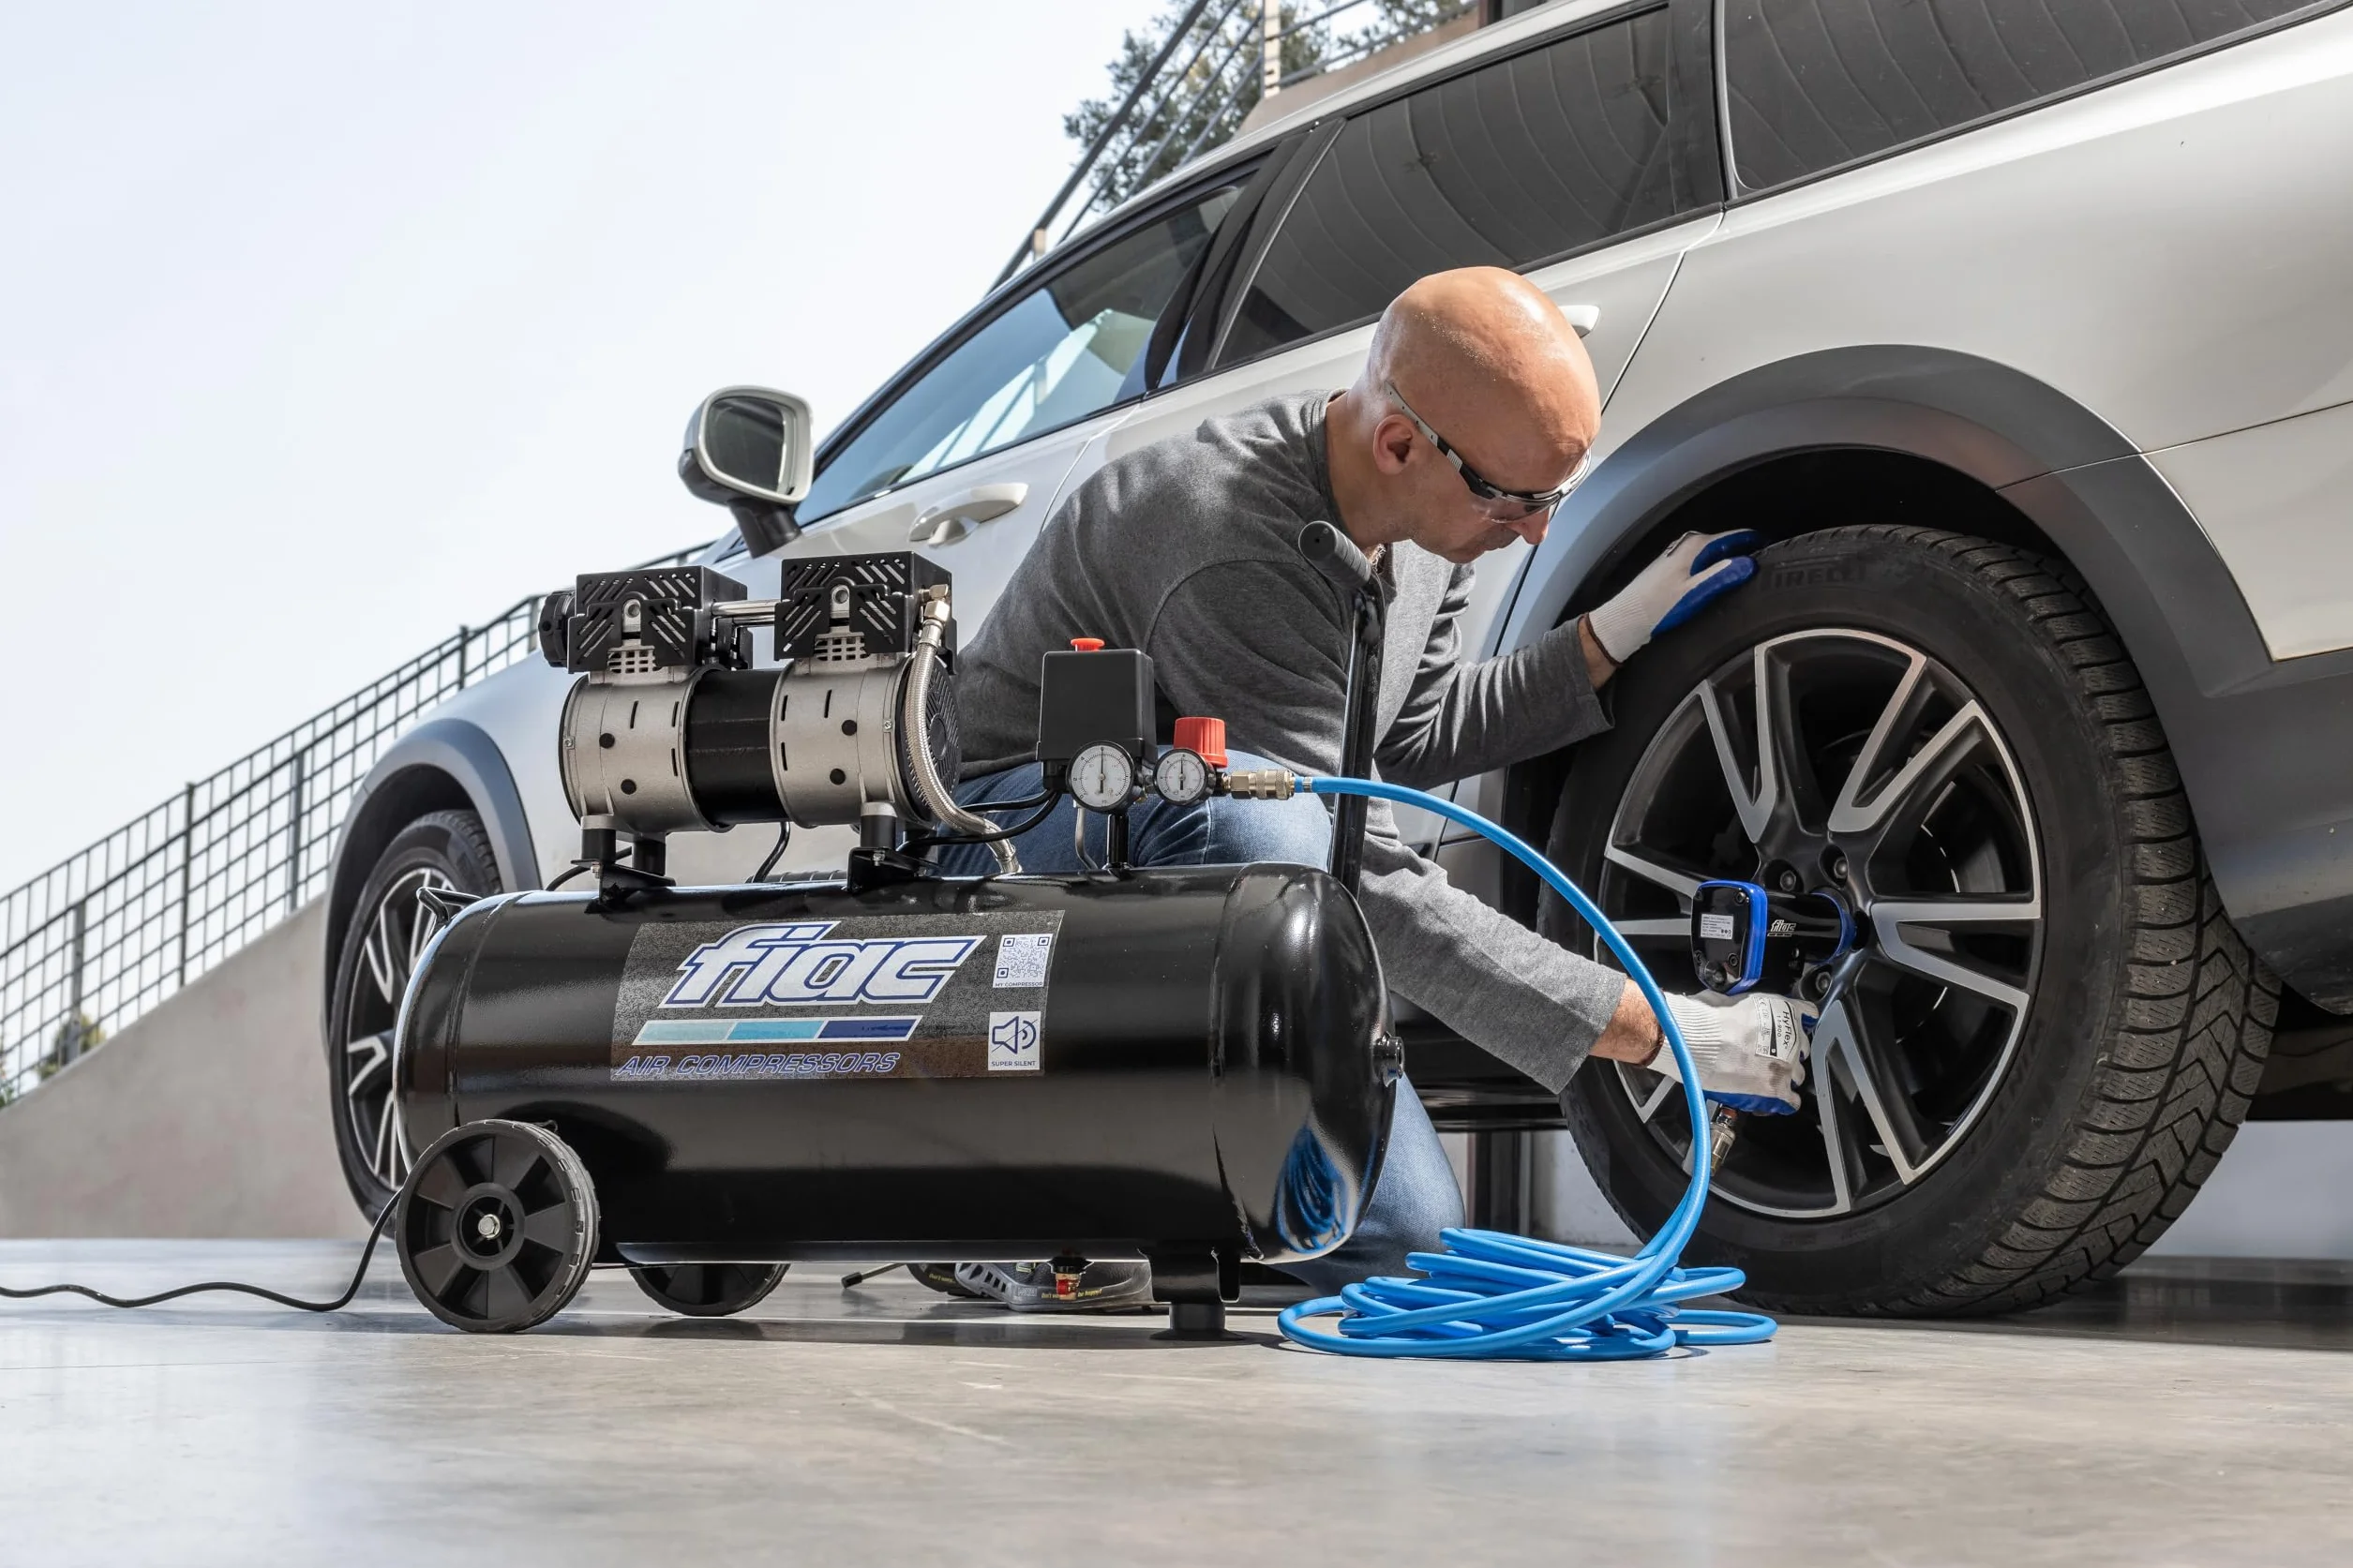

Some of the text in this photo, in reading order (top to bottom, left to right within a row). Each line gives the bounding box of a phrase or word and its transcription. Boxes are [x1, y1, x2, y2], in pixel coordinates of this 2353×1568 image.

[1771, 919, 1796, 932] fiac
[657, 920, 987, 1008] fiac
[617, 1053, 901, 1076] AIR COMPRESSORS
